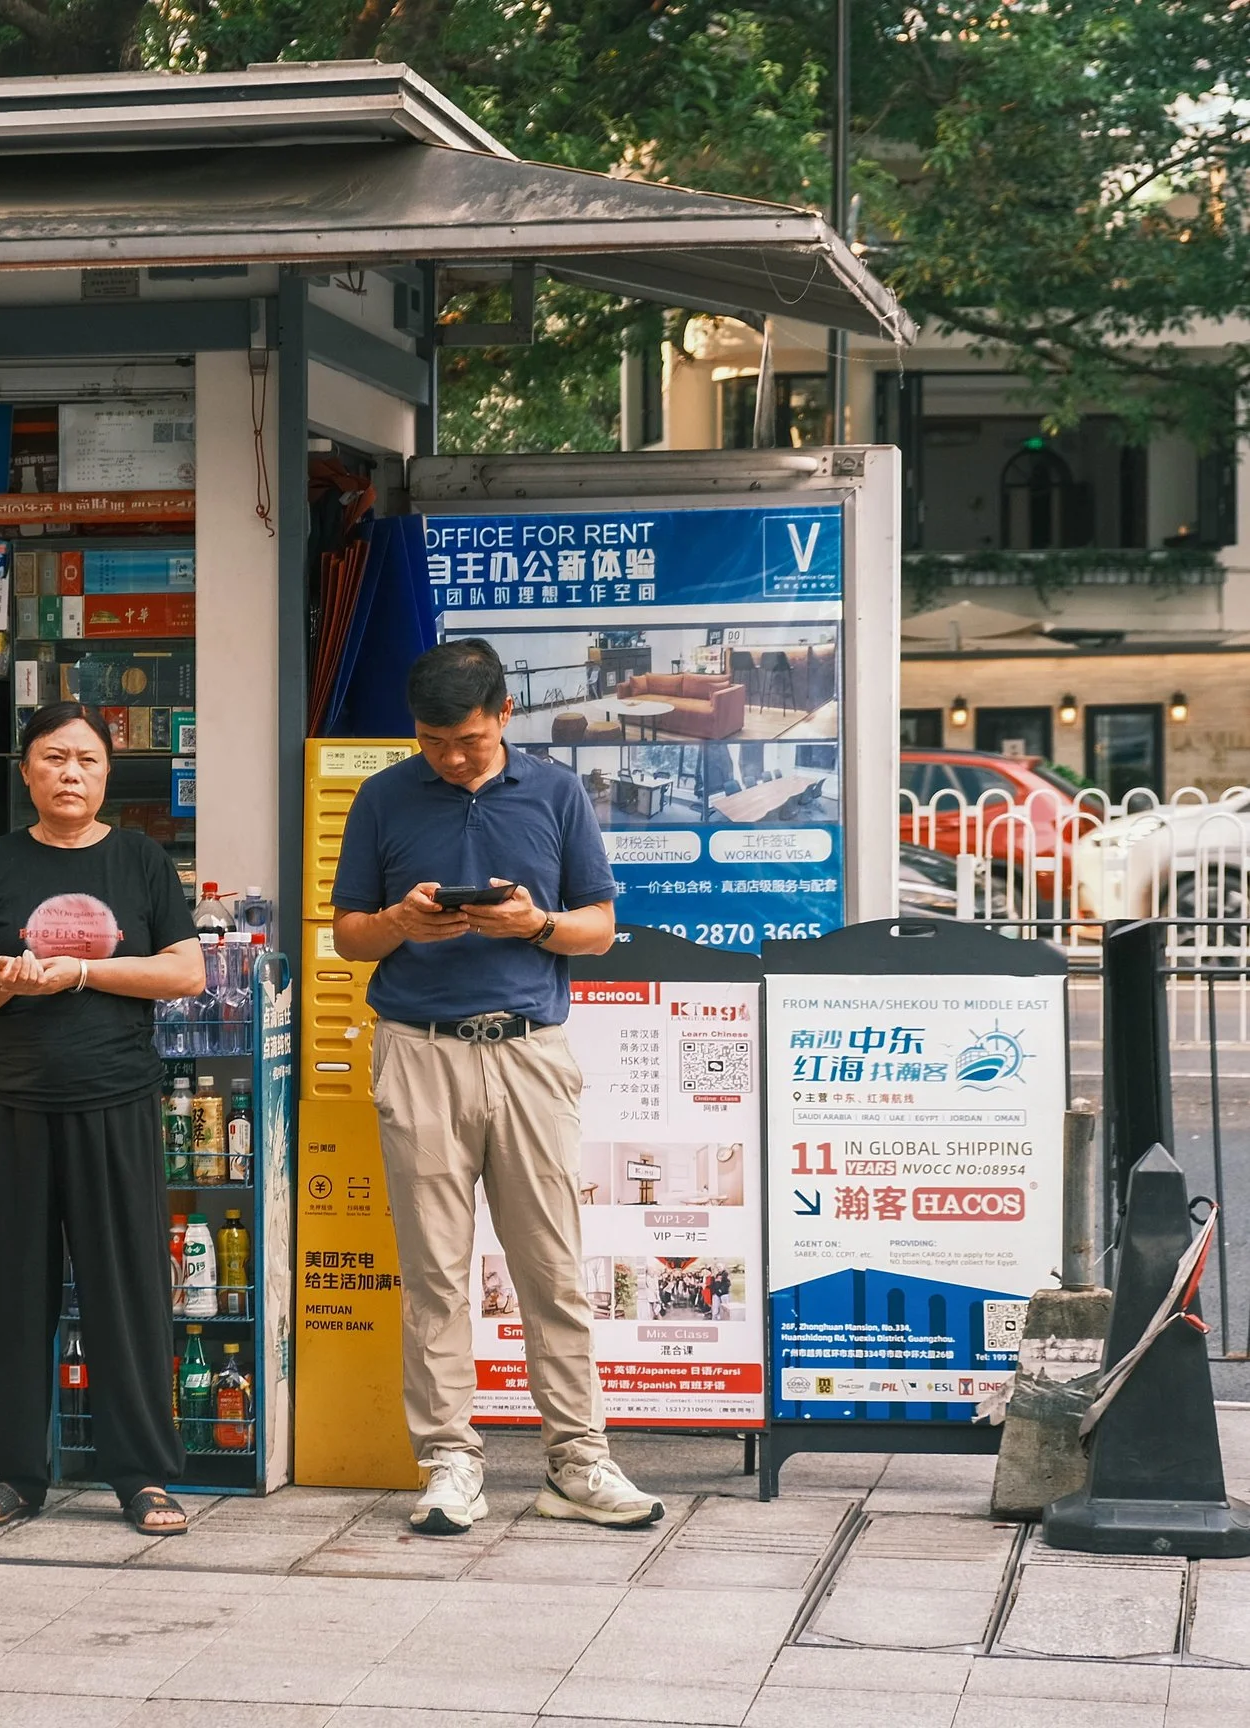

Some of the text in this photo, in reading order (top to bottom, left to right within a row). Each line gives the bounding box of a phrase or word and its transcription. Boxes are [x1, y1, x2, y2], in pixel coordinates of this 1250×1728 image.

[426, 522, 652, 550] OFFICE FOR RENT
[427, 549, 656, 585] 自主办公新体验
[433, 583, 656, 606] 团队的理想工作空间
[615, 835, 669, 849] 财税会计
[742, 833, 797, 848] 工作签证
[614, 850, 692, 862] ACCOUNTING
[724, 849, 812, 861] WORKING VISA
[721, 878, 837, 895] 真酒店级服务与配套
[695, 924, 753, 945] 2870
[587, 991, 644, 1001] SCHOOL
[783, 999, 1049, 1010] FROM NANSHA/SHEKOU TO MIDDLE EAST
[620, 1029, 659, 1039] 日常汉语
[790, 1026, 926, 1054] 南沙 中东
[619, 1043, 659, 1053] 商务汉语
[620, 1056, 660, 1066] HSK考试
[792, 1055, 949, 1082] 红海 找瀚客
[629, 1070, 660, 1079] 汉字课
[609, 1083, 660, 1093] 广交会汉语
[640, 1097, 660, 1107] 粤语
[805, 1093, 914, 1104] 主营 中东、红海航线
[703, 1105, 728, 1113] 网络课
[620, 1110, 660, 1121] 少儿汉语
[889, 1114, 905, 1122] UAE
[915, 1114, 939, 1122] EGYPT
[950, 1114, 982, 1122] JORDAN
[994, 1114, 1020, 1122] OMAN
[845, 1141, 1033, 1156] IN GLOBAL SHIPPING
[791, 1142, 837, 1175] 11
[846, 1161, 896, 1175] YEARS
[902, 1163, 1026, 1176] NVOCC NO:08954
[834, 1186, 907, 1220] 瀚客
[916, 1193, 1021, 1216] HACOS
[654, 1215, 695, 1224] VIP1-2
[653, 1232, 707, 1242] VIP 一对二
[794, 1240, 841, 1248] AGENT ON:
[890, 1239, 937, 1248] PROVIDING:
[305, 1251, 374, 1269] 美团充电
[890, 1251, 920, 1260] Egyptian
[964, 1251, 982, 1260] apply
[935, 1259, 958, 1267] freight
[306, 1305, 353, 1315] MEITUAN
[306, 1320, 374, 1331] POWER BANK
[799, 1323, 843, 1333] Zhonghuan
[845, 1323, 880, 1333] Mansion,
[646, 1330, 709, 1339] Mix Class
[781, 1334, 833, 1343] Huanshidong
[849, 1334, 876, 1342] Yuexiu
[660, 1345, 693, 1355] 混合课
[975, 1353, 990, 1361] Tel:
[1008, 1353, 1018, 1361] 28
[490, 1364, 522, 1373] Arabic
[505, 1378, 528, 1388] 波斯
[637, 1380, 726, 1391] Spanish 西班牙语
[881, 1382, 898, 1392] PIL
[934, 1382, 954, 1392] ESL
